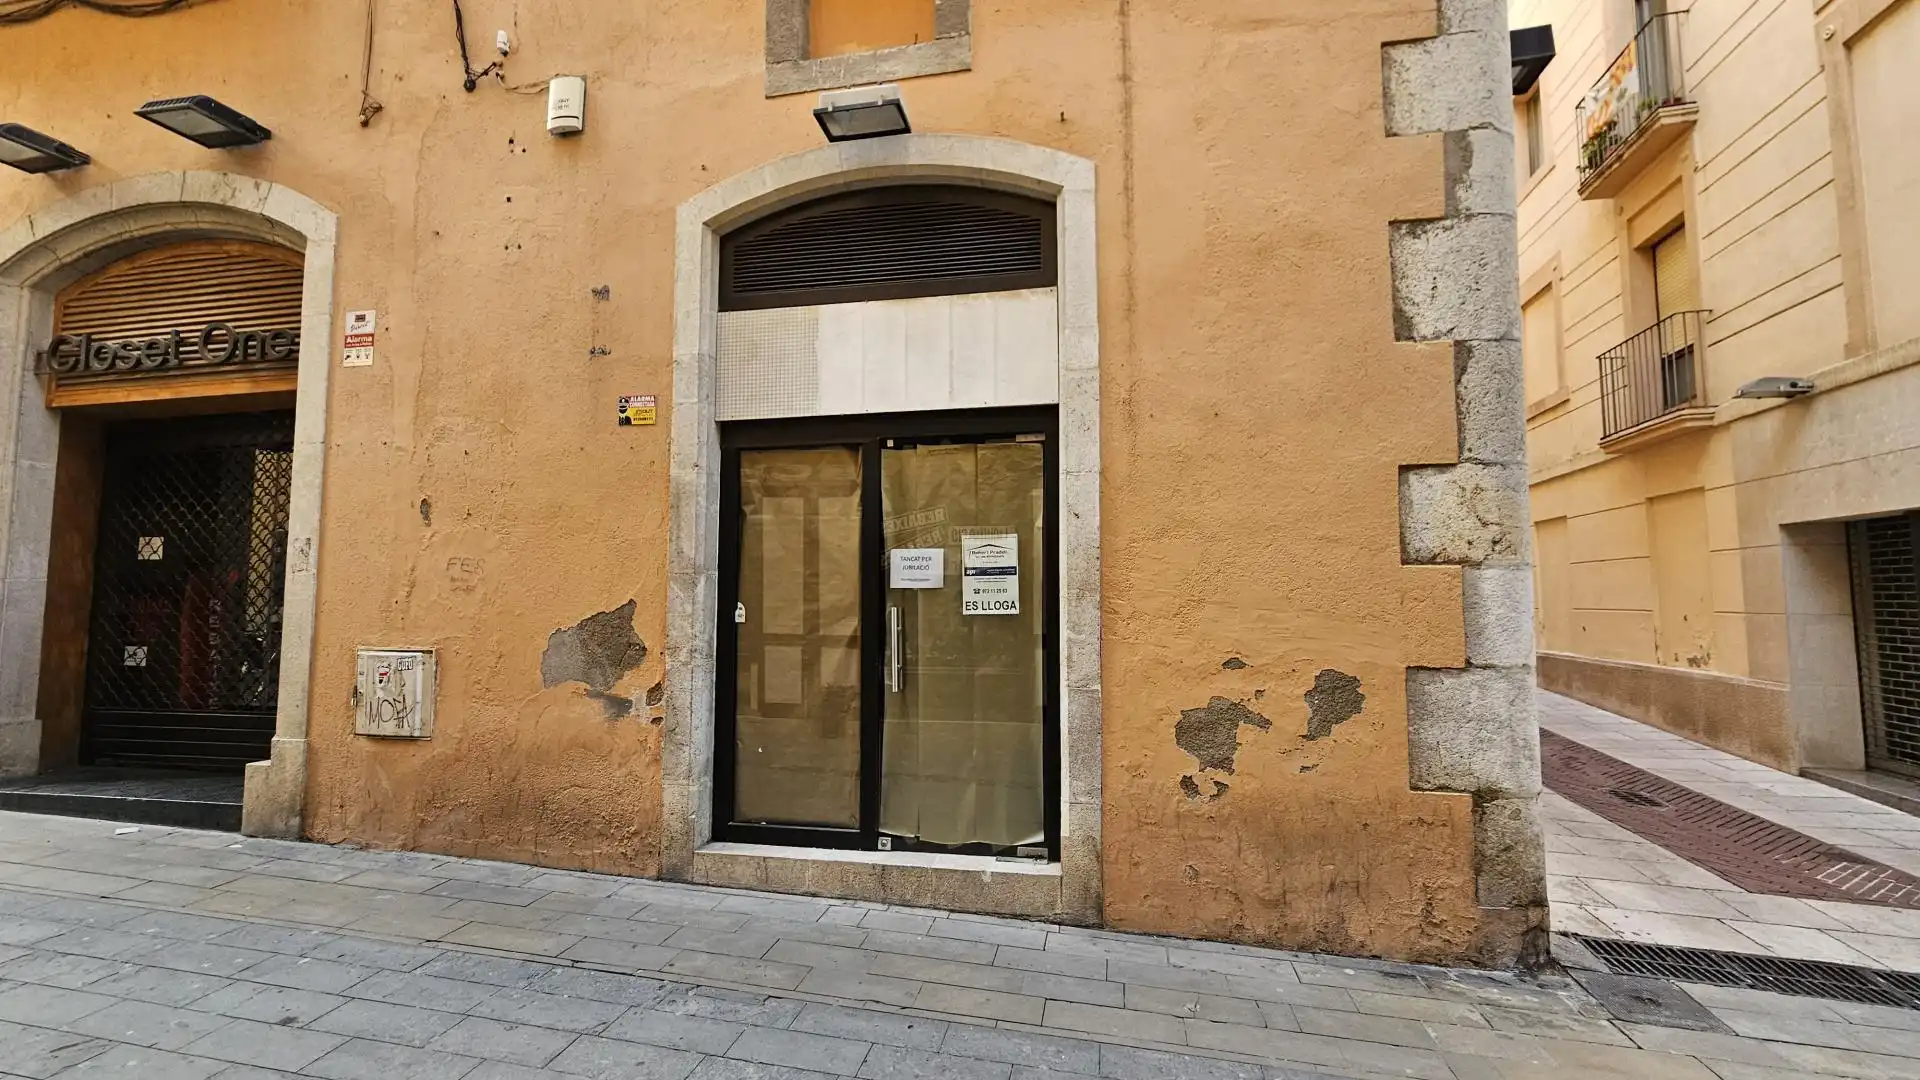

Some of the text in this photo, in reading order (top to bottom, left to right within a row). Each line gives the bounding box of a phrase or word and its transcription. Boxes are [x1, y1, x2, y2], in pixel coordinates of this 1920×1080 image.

[346, 335, 373, 343] Alarma
[47, 322, 296, 373] Closet One
[965, 601, 1017, 611] ES LLOGA
